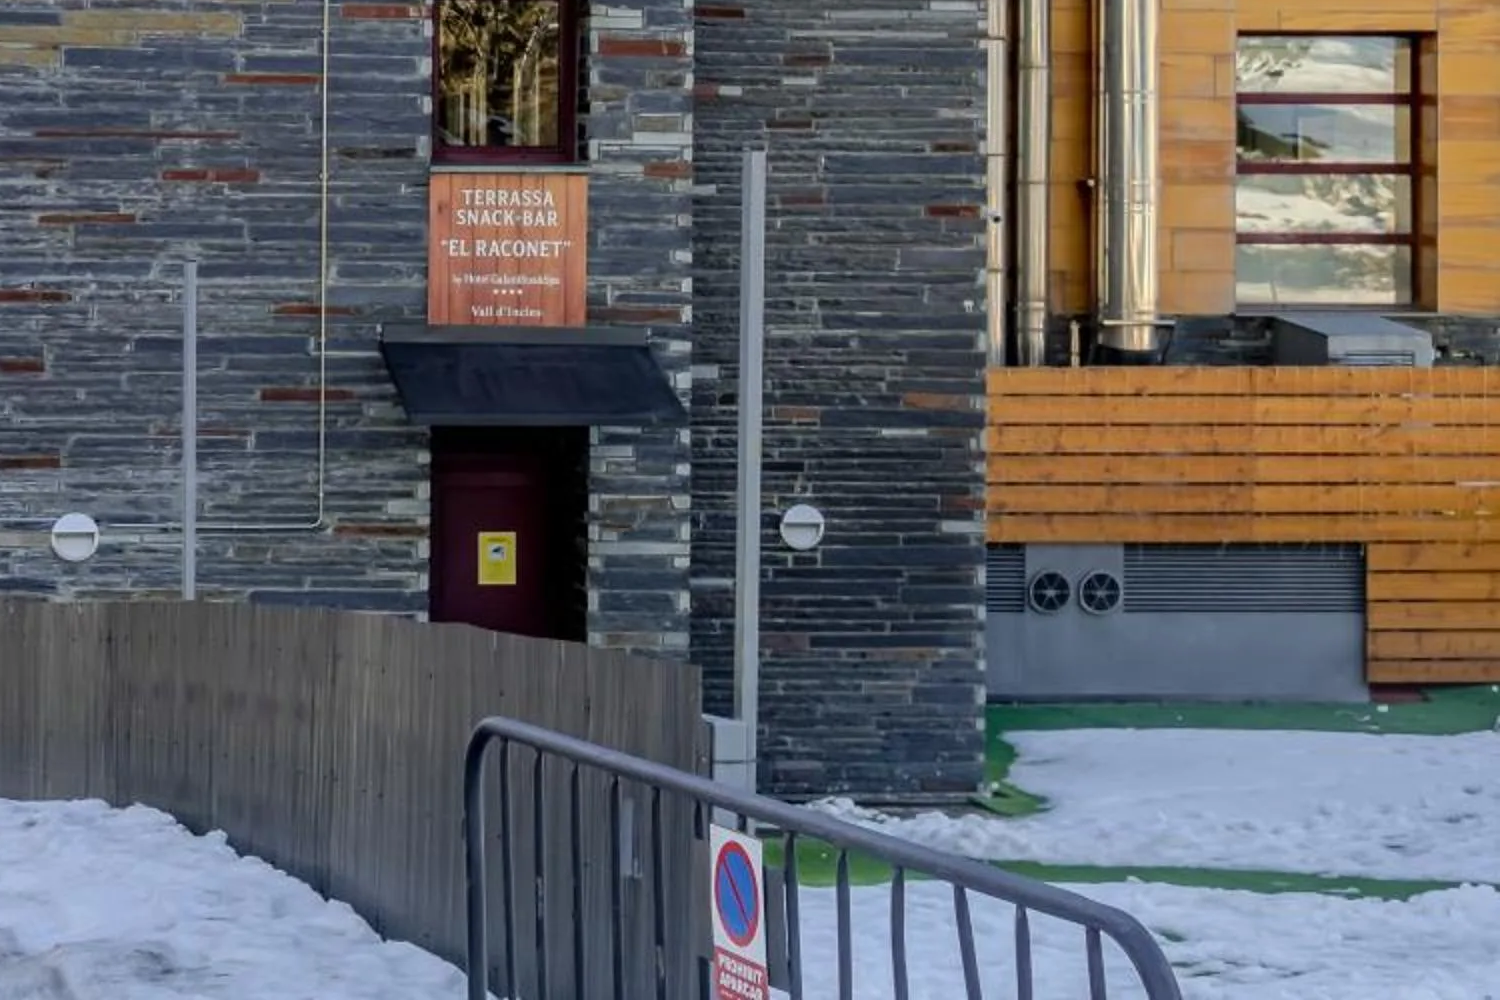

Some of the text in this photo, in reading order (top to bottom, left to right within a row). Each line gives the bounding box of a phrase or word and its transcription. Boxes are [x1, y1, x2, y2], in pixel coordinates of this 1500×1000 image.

[461, 189, 554, 207] TERRASSA
[456, 209, 558, 227] SNACK-BAR
[471, 305, 493, 317] Vall
